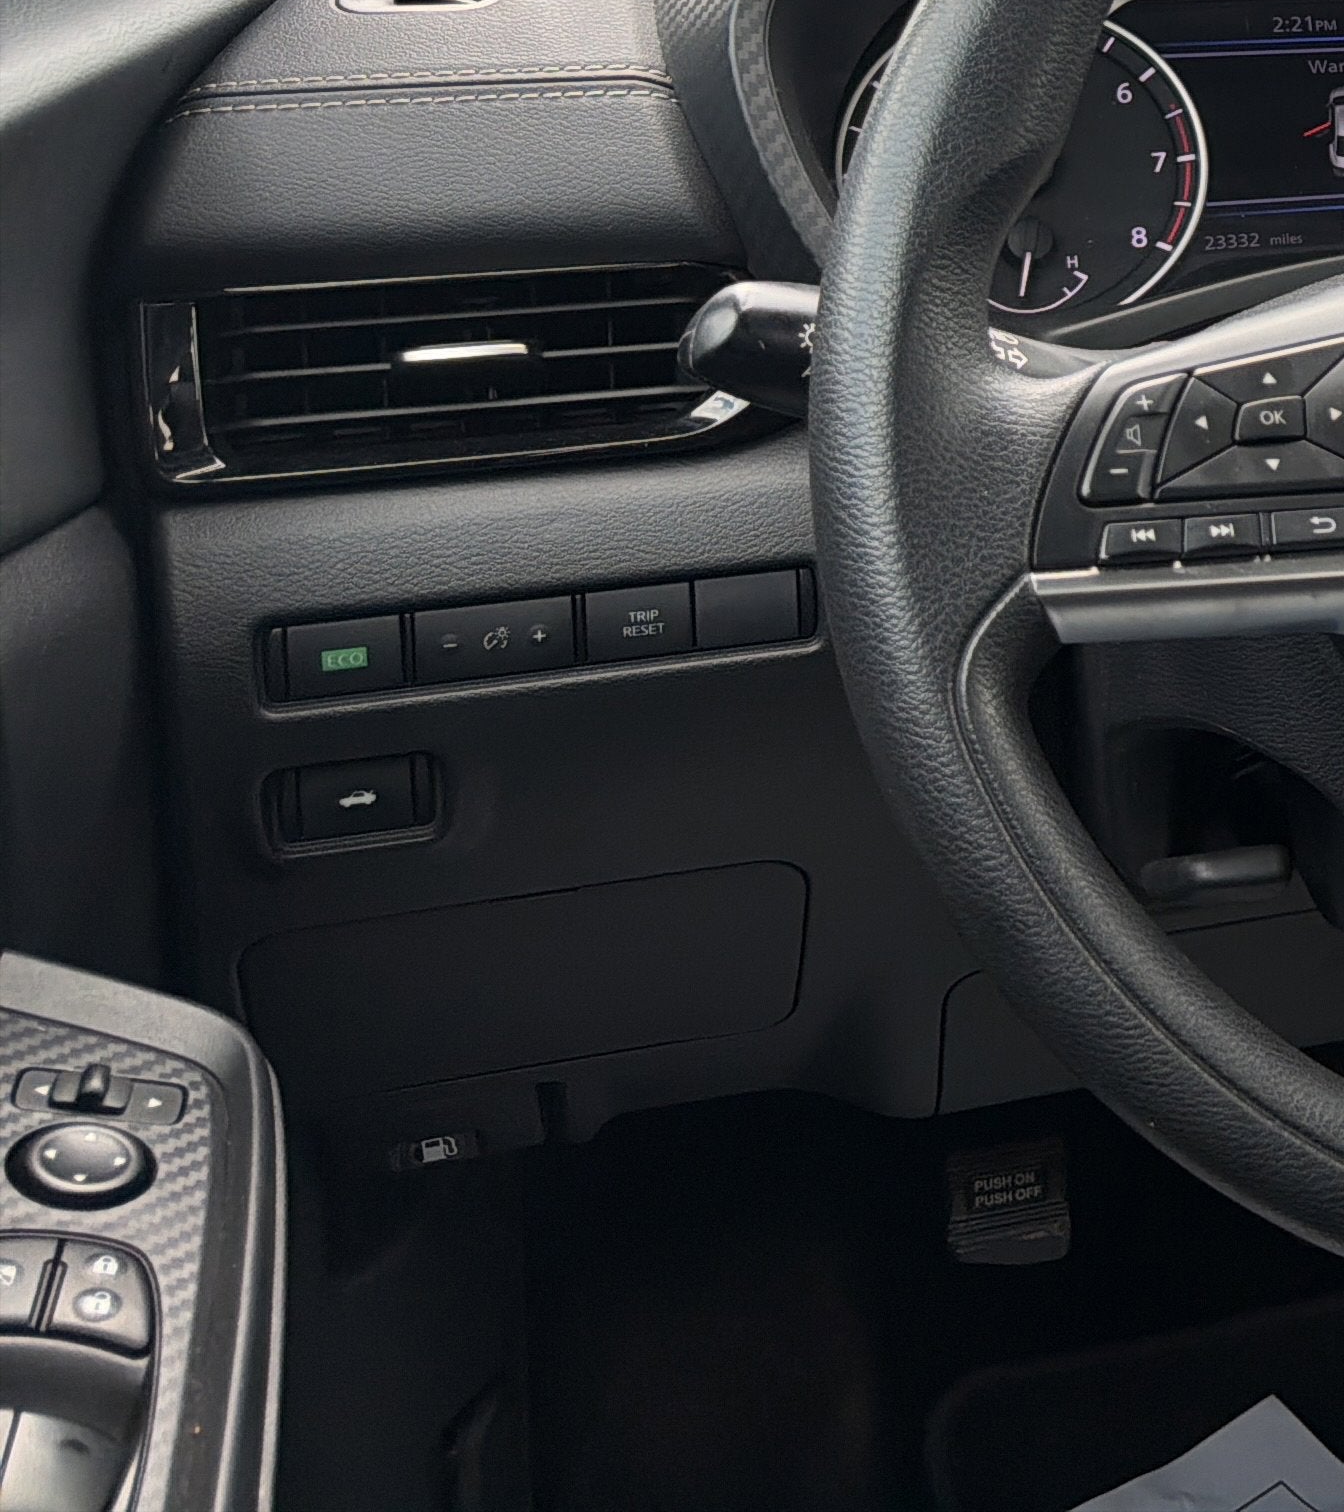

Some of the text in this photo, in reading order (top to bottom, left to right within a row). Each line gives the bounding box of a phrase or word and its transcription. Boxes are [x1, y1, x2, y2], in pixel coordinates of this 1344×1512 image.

[1116, 82, 1133, 104] 6
[1150, 151, 1167, 173] 7
[1130, 226, 1148, 248] 8
[1204, 232, 1304, 250] 23332 miles
[1065, 254, 1080, 269] H
[1259, 409, 1287, 425] OK
[628, 608, 659, 624] TRIP
[622, 621, 665, 639] RESET
[326, 650, 365, 668] ECO
[974, 1171, 1036, 1193] PUSH ON
[975, 1185, 1042, 1207] PUSH OFF
